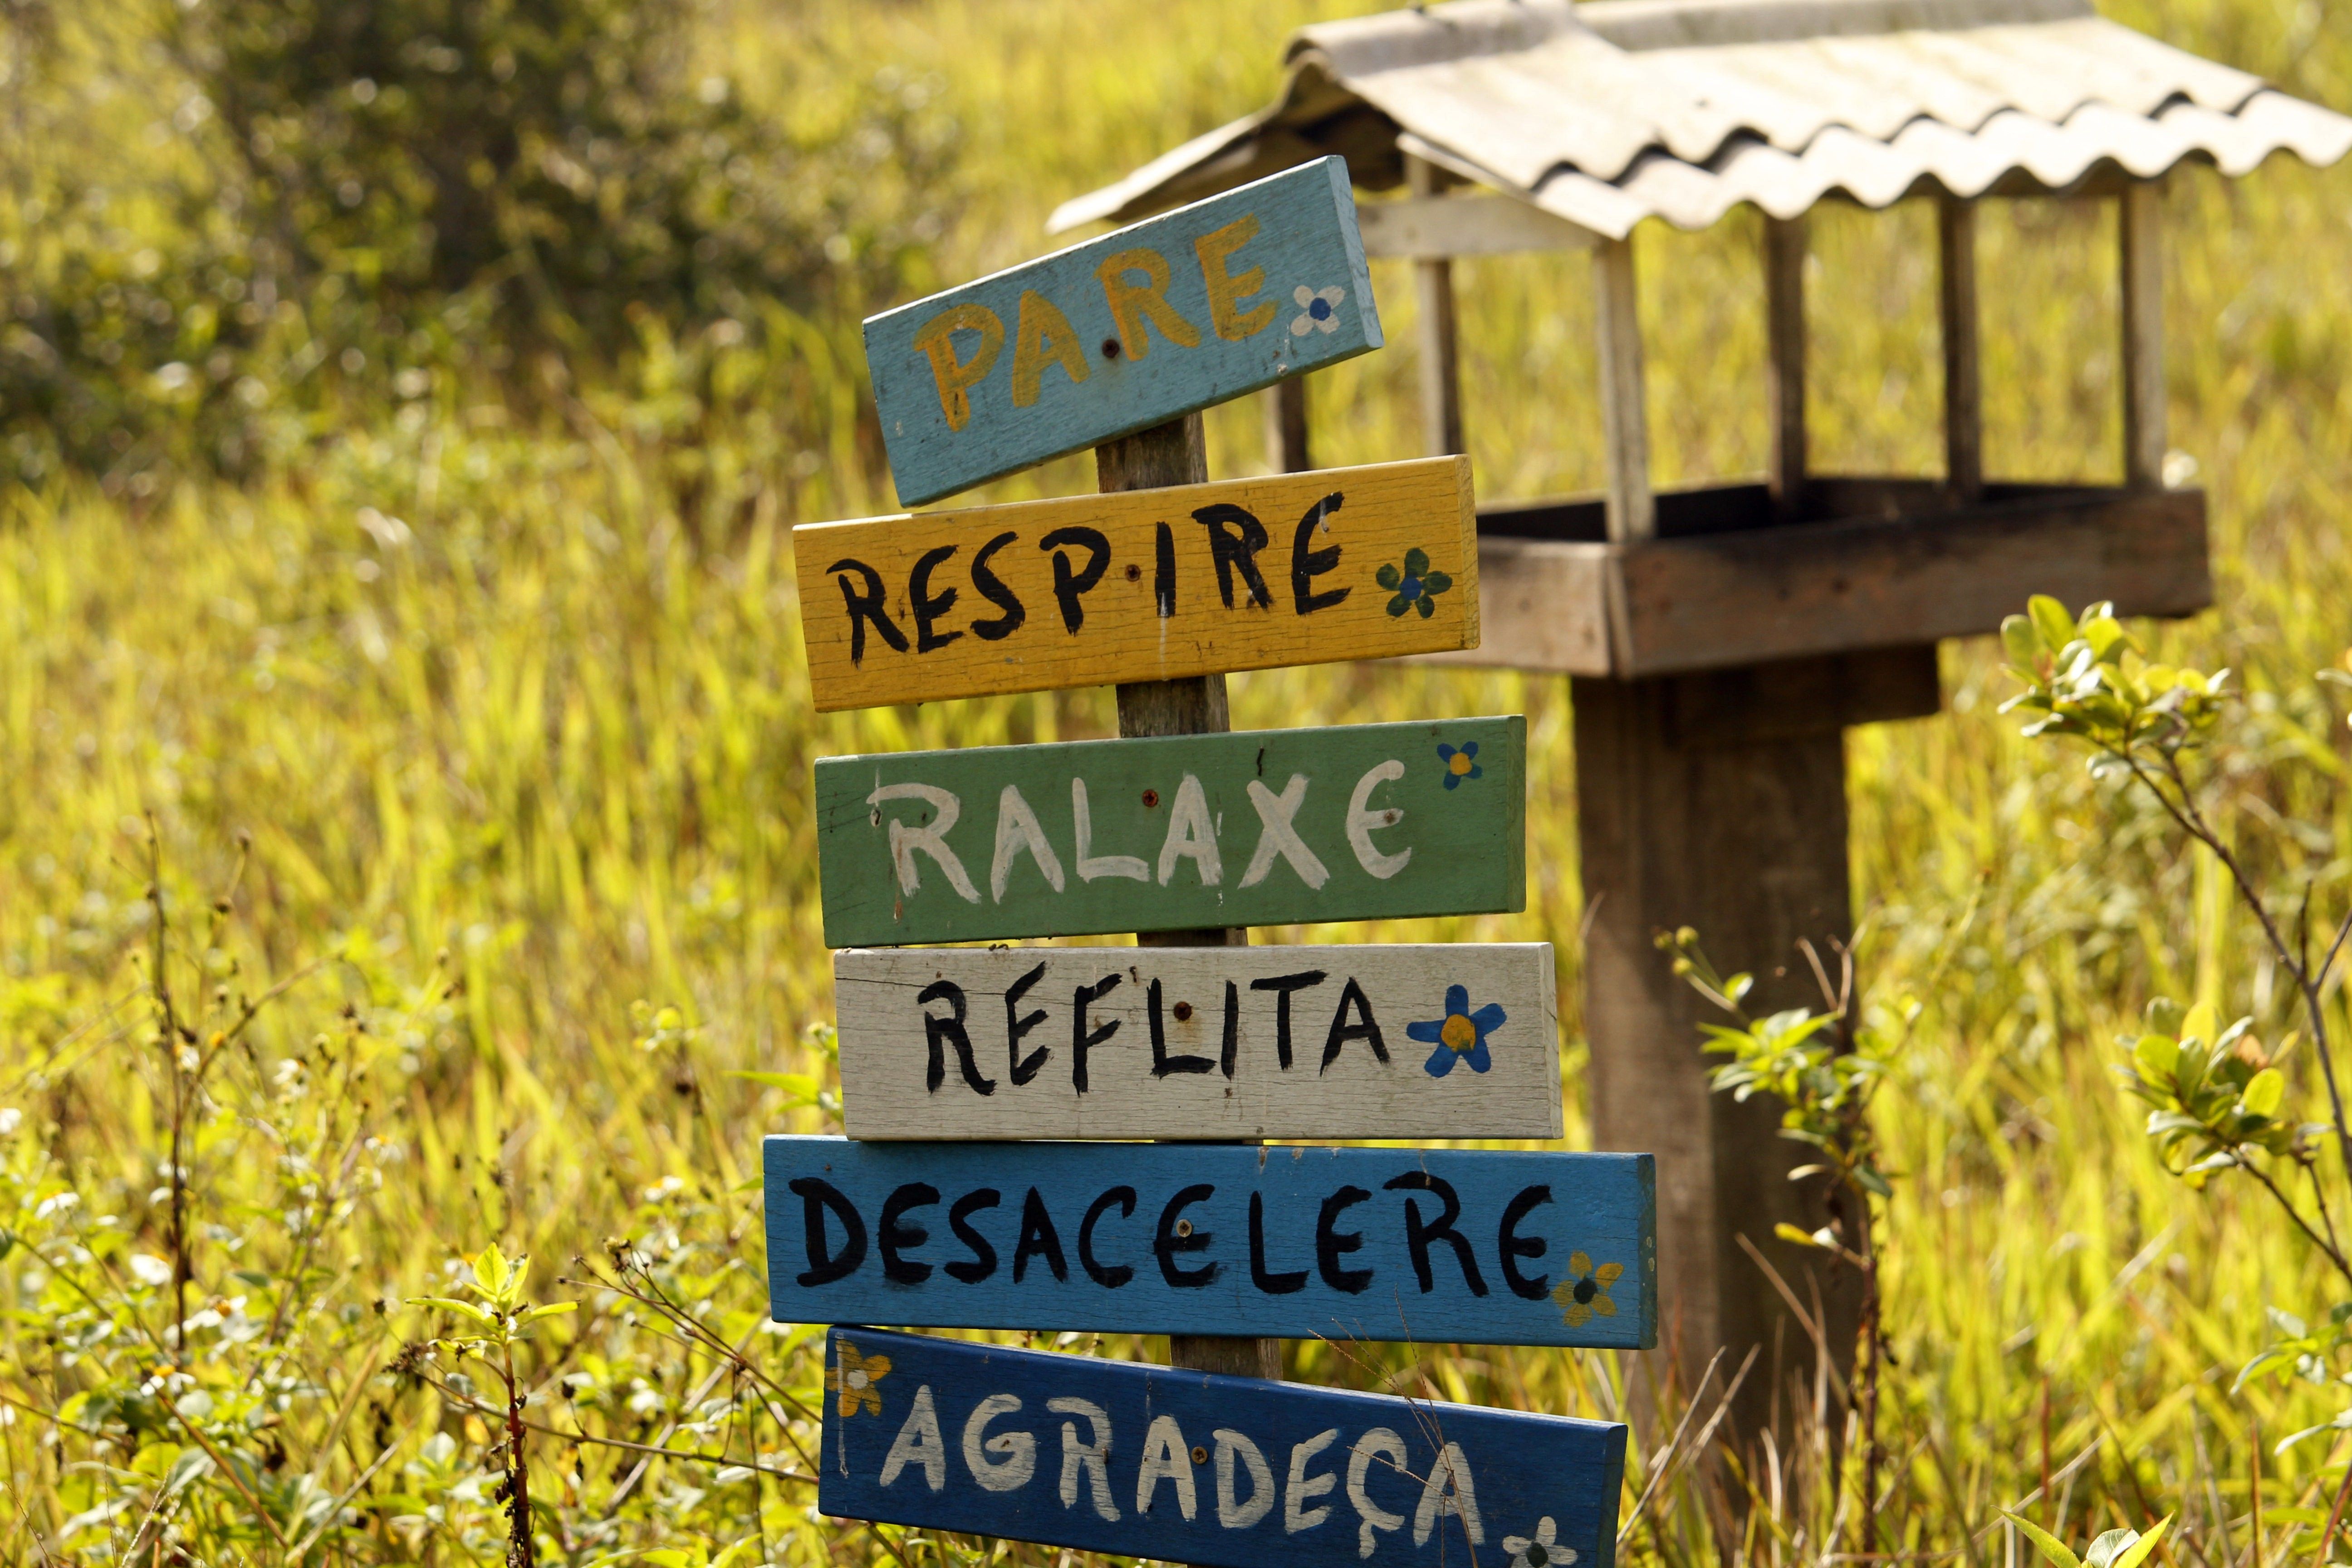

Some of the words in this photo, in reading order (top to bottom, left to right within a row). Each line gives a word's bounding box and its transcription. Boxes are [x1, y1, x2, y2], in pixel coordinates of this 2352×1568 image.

[913, 213, 1279, 431] PARE
[826, 491, 1352, 667] RESPIRE
[866, 759, 1412, 904] RALAXE
[917, 960, 1390, 1096] REFLITA
[789, 1171, 1553, 1301] DESACELERE
[880, 1384, 1486, 1559] AGRADEÇA
